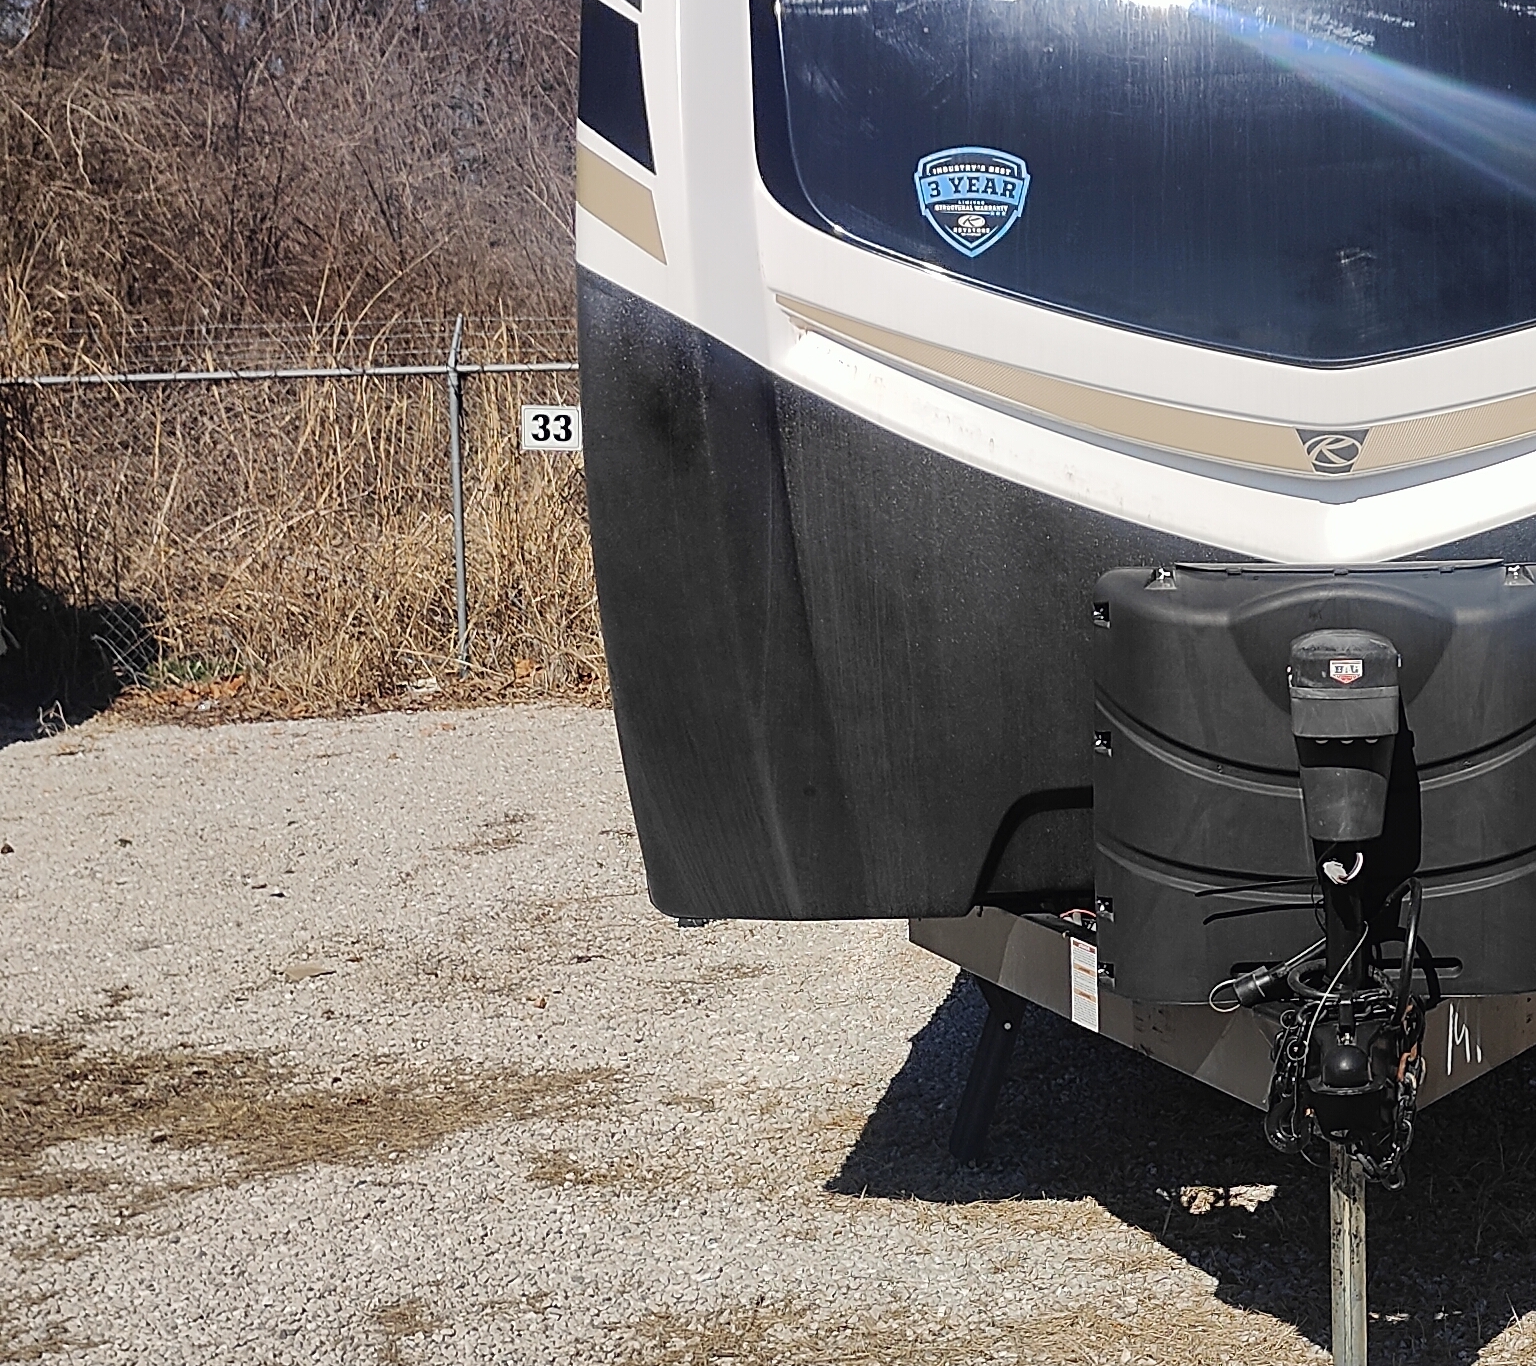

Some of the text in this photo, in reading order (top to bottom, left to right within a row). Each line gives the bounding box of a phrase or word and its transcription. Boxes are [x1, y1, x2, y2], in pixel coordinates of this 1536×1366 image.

[927, 176, 1017, 199] 3 YEAR
[531, 414, 573, 442] 33
